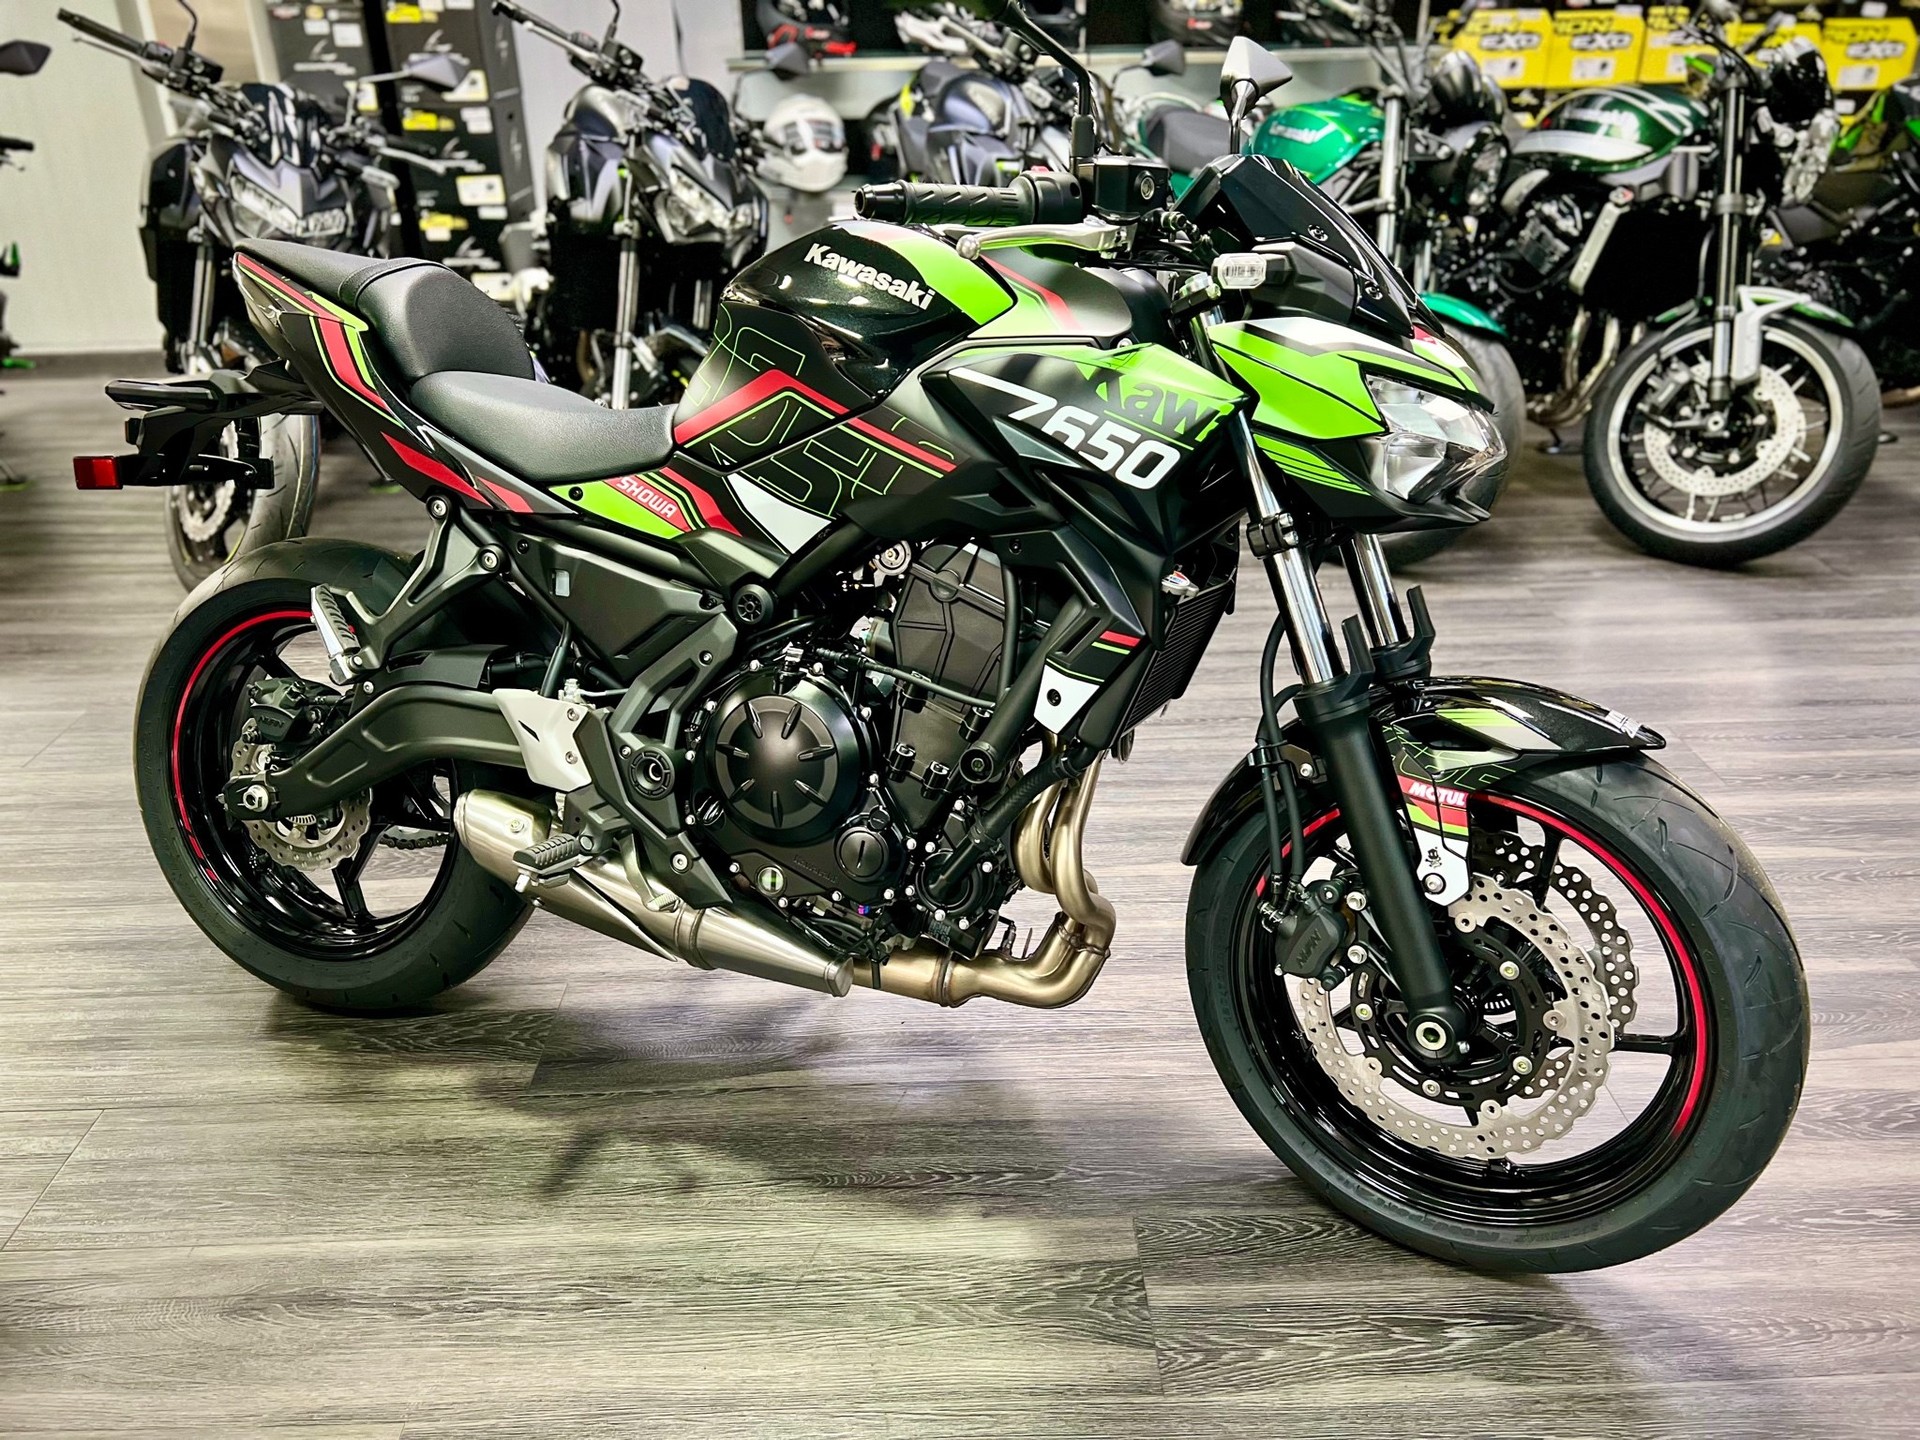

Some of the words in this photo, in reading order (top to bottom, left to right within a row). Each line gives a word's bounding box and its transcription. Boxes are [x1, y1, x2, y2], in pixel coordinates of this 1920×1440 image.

[1480, 32, 1543, 50] EXO
[1570, 32, 1633, 50] EXO
[803, 242, 936, 311] Kawasaki
[616, 477, 677, 519] SHOWA
[1408, 781, 1467, 806] MOTUL
